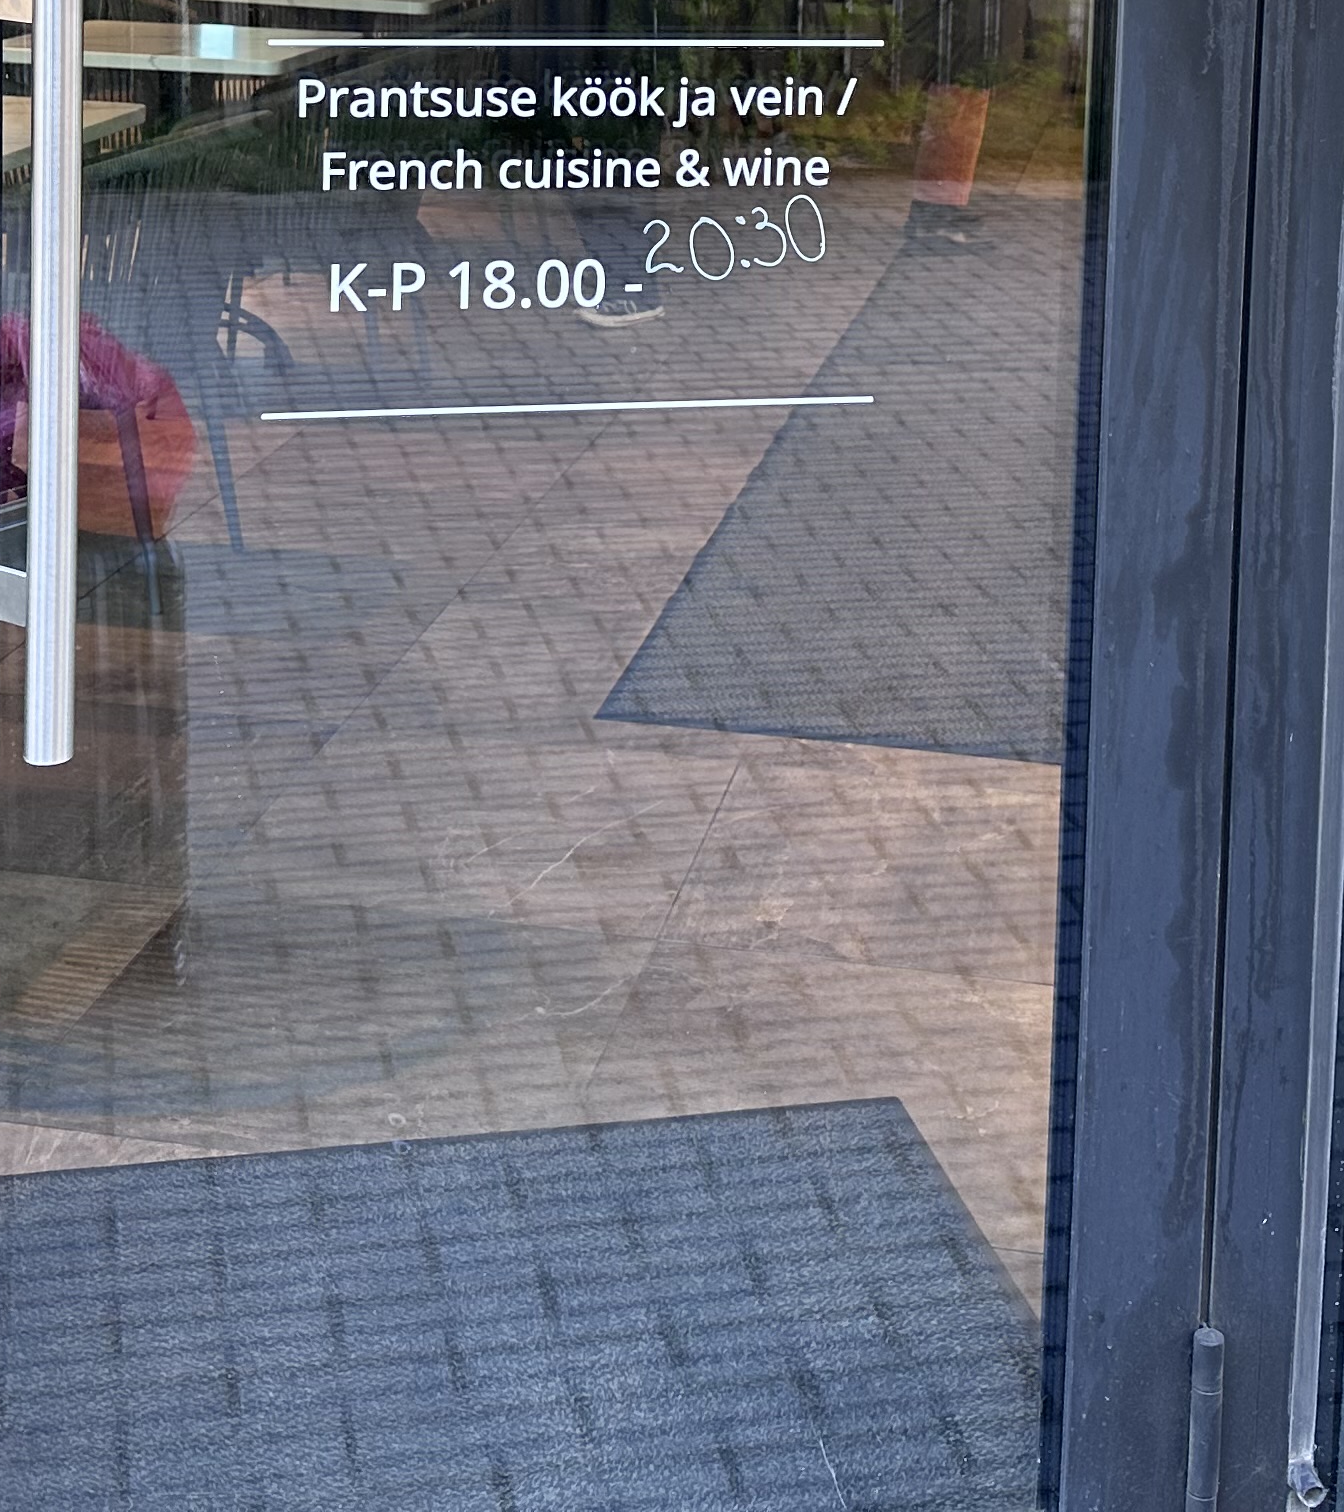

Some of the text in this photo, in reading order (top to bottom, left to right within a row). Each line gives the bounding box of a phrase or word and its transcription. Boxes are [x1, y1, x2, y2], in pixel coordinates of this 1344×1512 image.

[297, 75, 858, 128] Prantsuse köök ja vein /
[321, 148, 831, 191] French cuisine & wine
[329, 261, 427, 312] K-P
[446, 258, 606, 312] 18.00
[643, 195, 827, 281] 20:30
